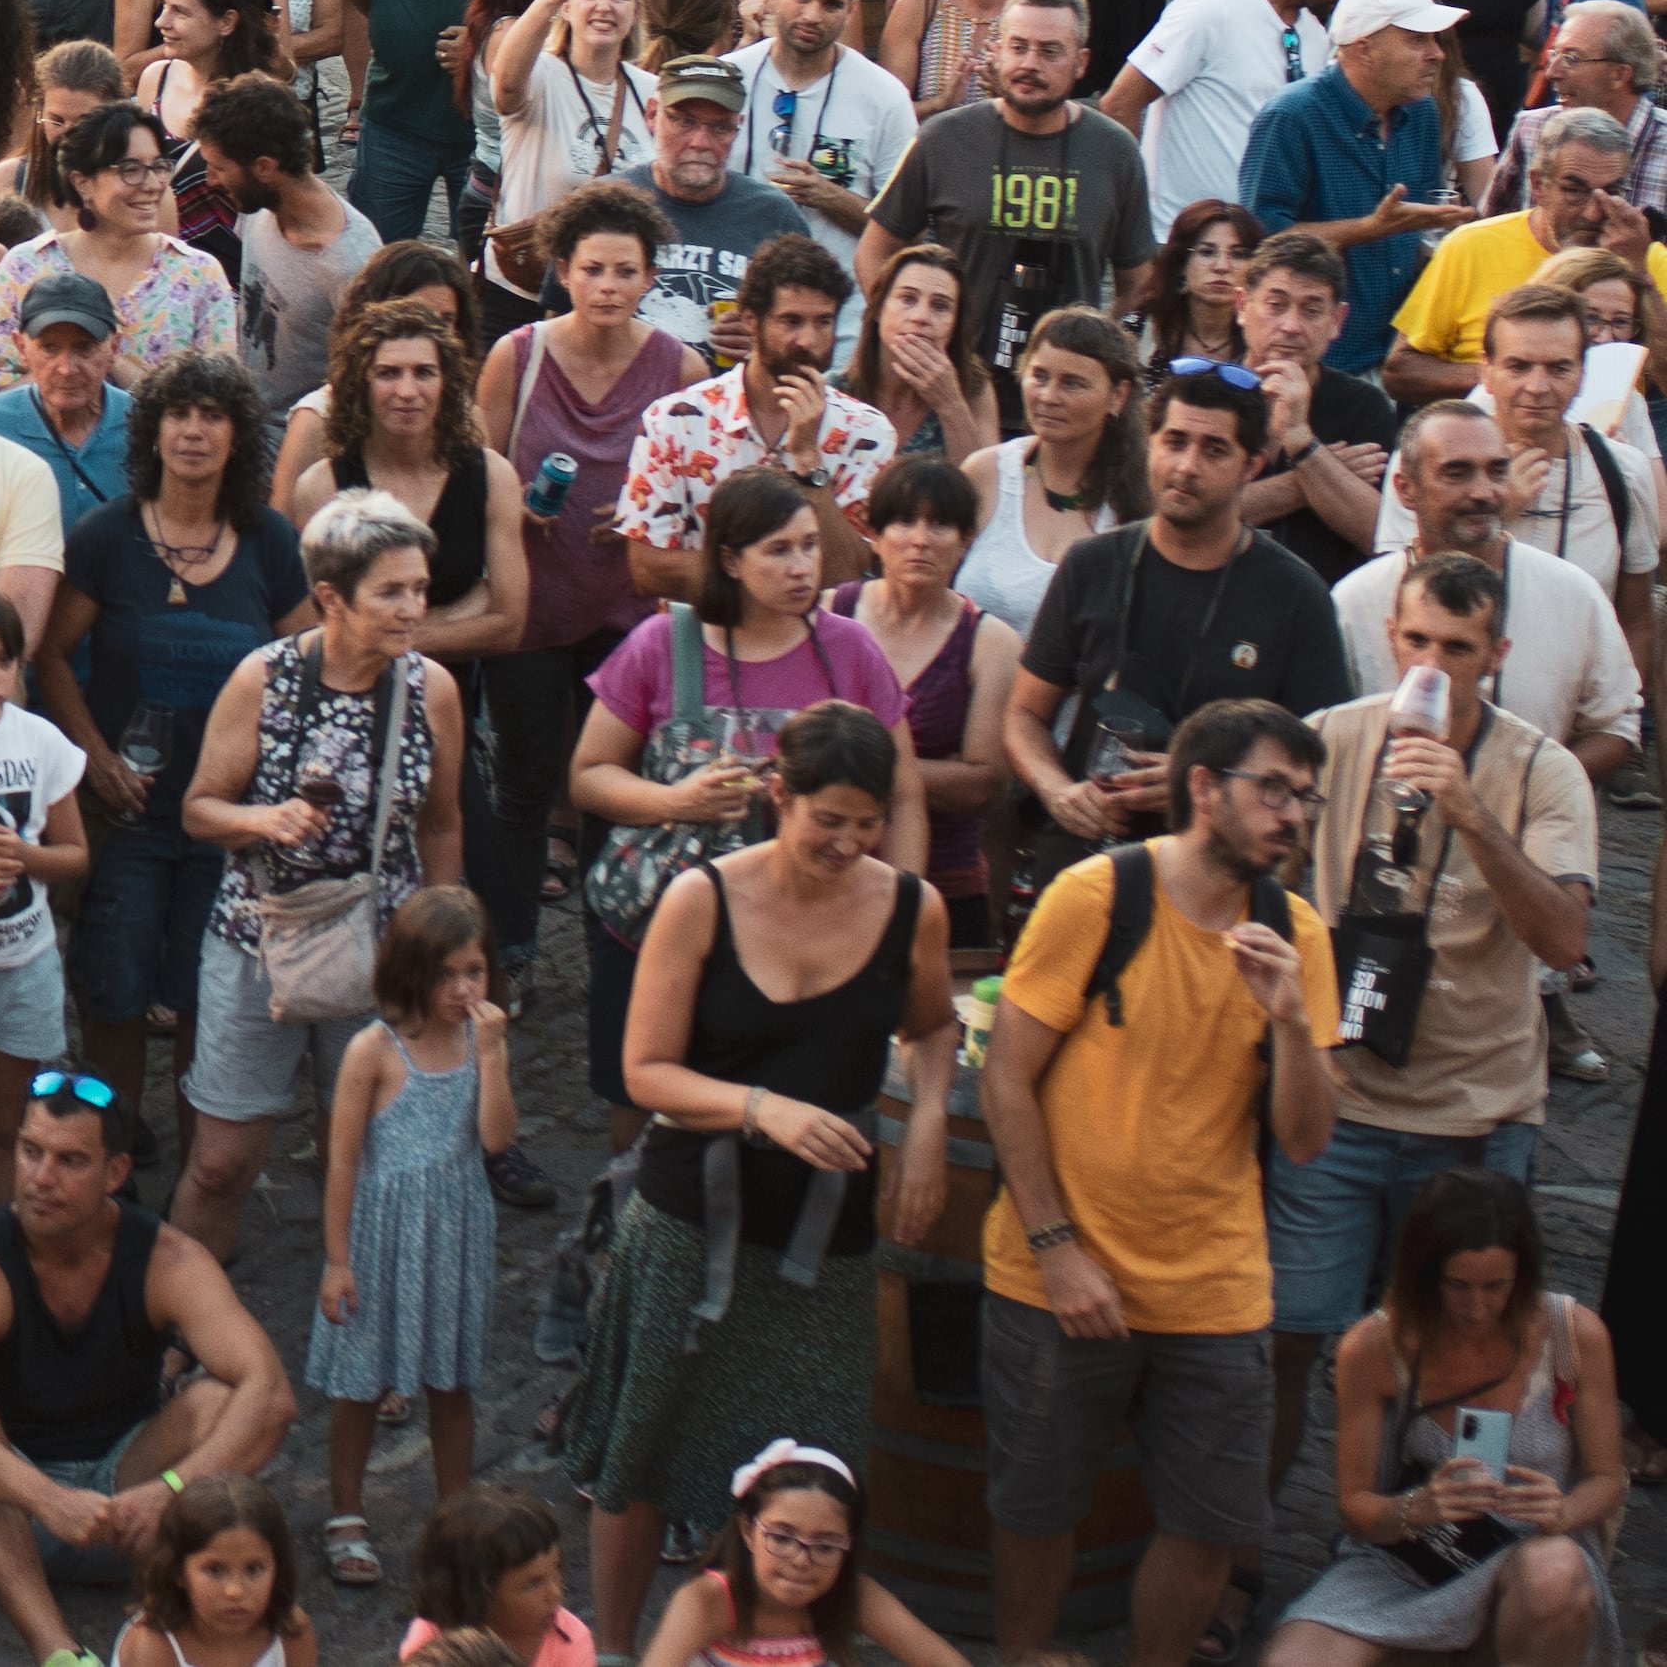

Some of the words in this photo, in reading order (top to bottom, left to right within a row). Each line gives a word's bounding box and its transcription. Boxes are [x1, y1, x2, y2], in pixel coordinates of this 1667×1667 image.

[989, 173, 1078, 230] 1981
[1001, 312, 1018, 329] SO
[998, 339, 1012, 355] TA
